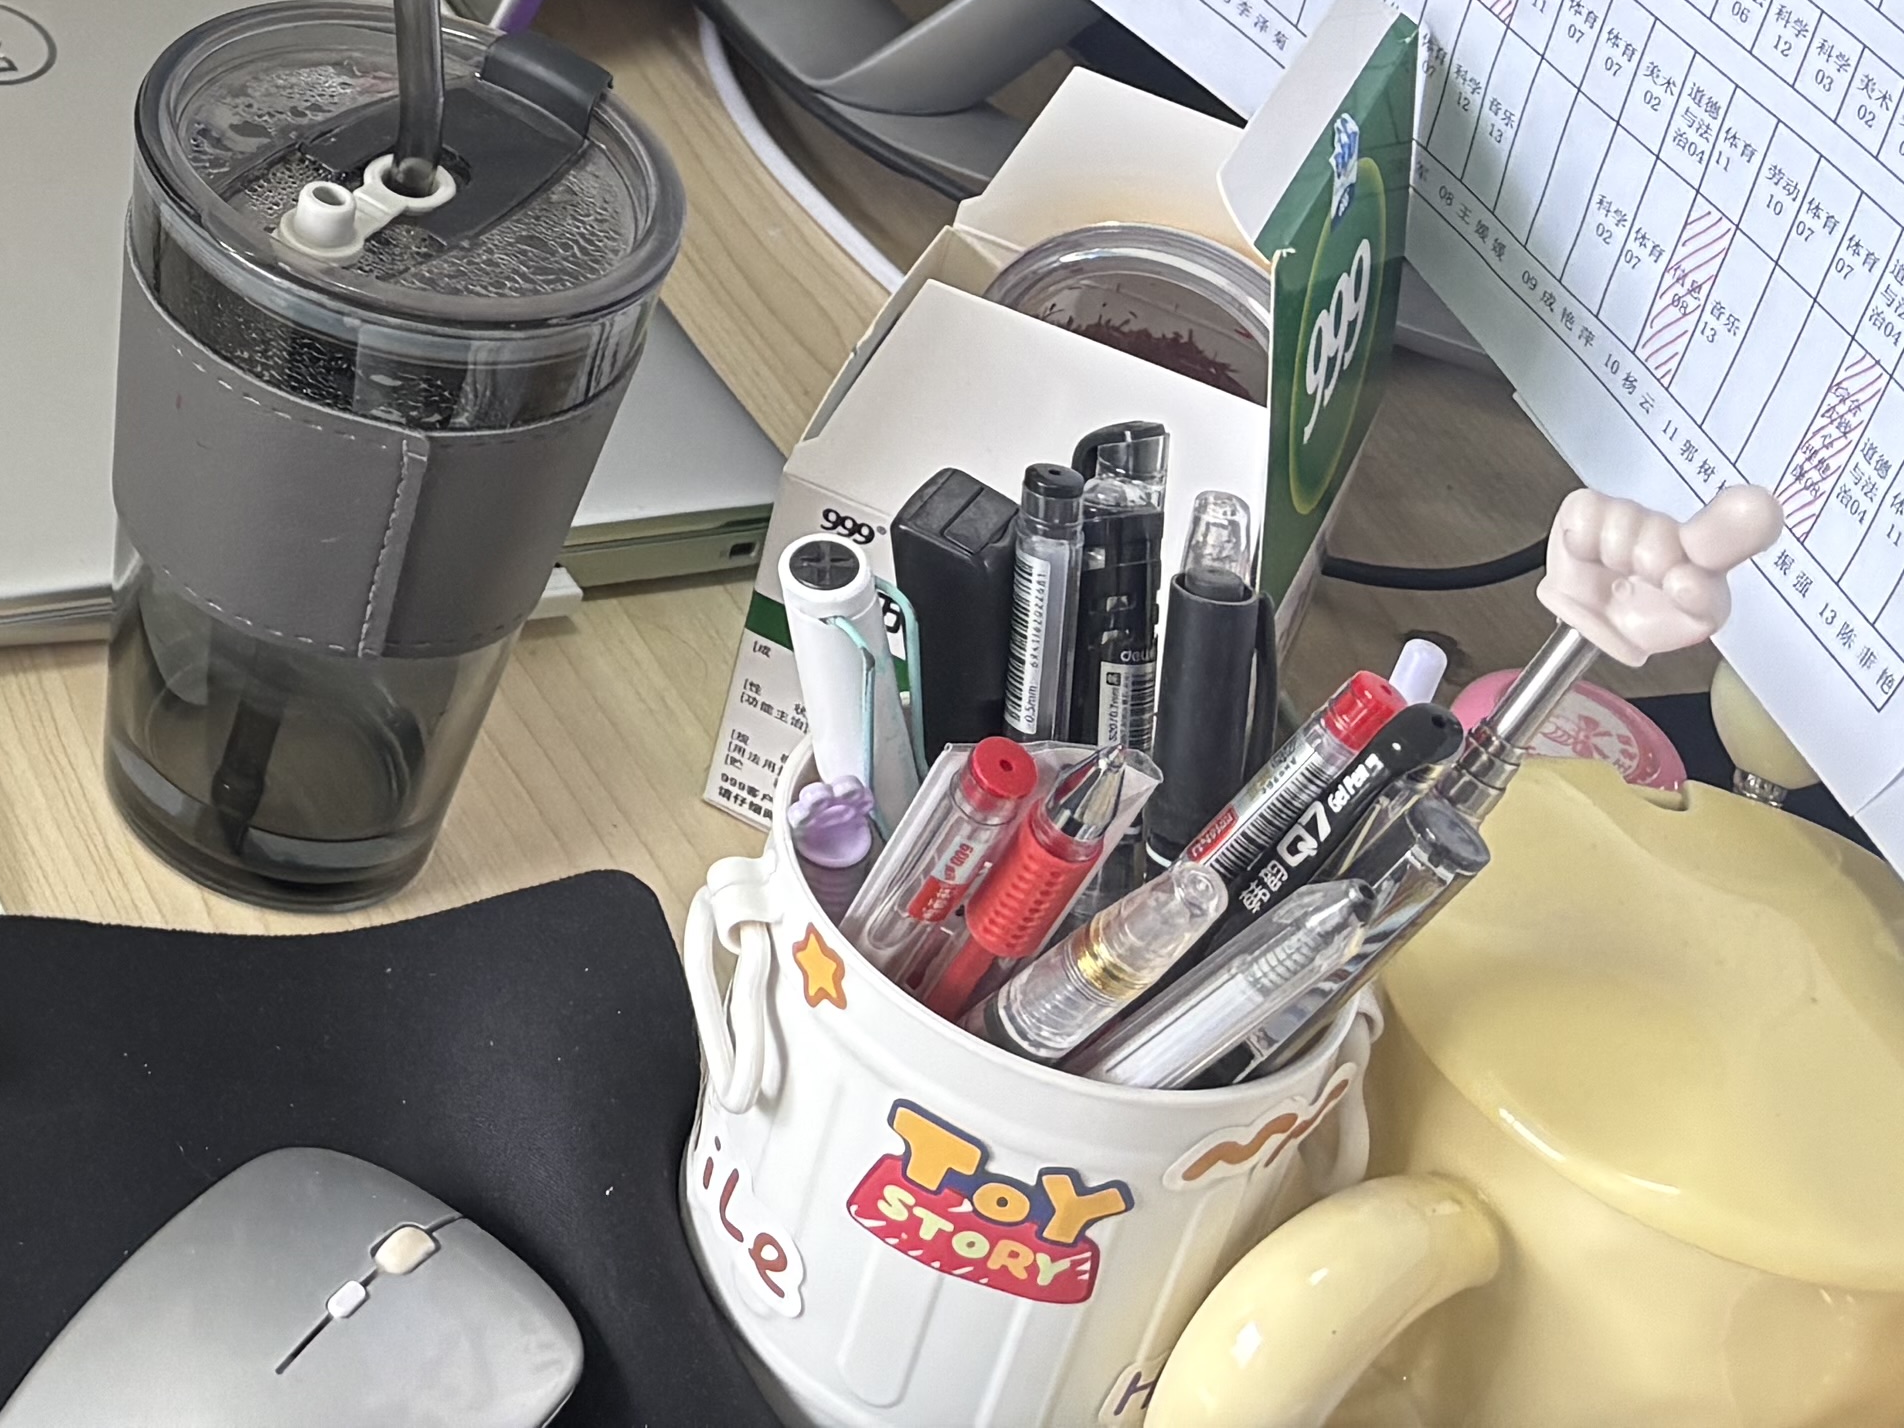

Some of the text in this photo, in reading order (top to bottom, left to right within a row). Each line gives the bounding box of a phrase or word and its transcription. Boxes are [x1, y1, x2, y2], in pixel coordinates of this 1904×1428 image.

[1299, 236, 1372, 418] 999
[1604, 354, 1620, 374] 10
[821, 507, 876, 546] 999
[1276, 799, 1332, 867] Q7
[889, 1099, 1134, 1245] TOY
[876, 1184, 1071, 1286] STORY
